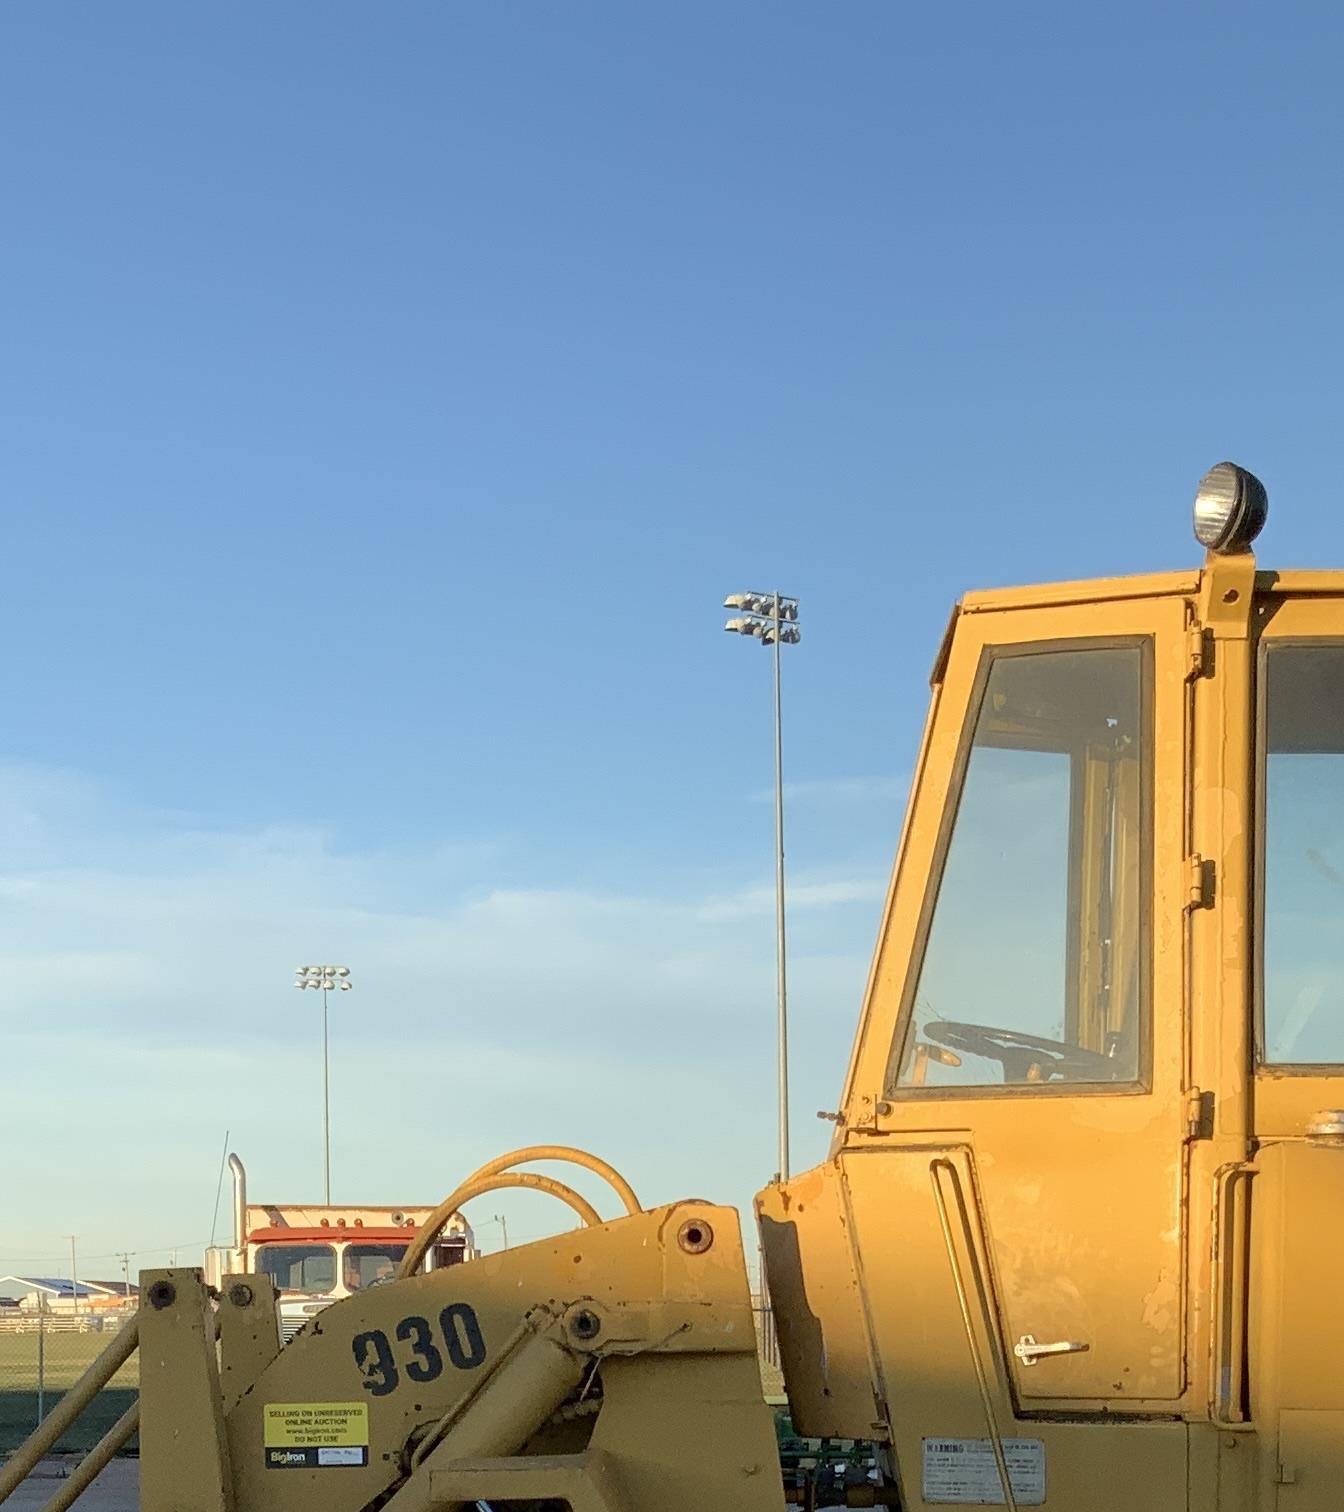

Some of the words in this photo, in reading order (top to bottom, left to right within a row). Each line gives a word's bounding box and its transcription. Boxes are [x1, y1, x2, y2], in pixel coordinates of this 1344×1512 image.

[352, 1303, 487, 1397] 930
[269, 1410, 300, 1418] SELLING
[314, 1409, 363, 1417] UNRESERVED
[314, 1418, 348, 1426] AUCTION
[323, 1435, 339, 1443] USE
[926, 1444, 964, 1453] WARNING
[270, 1451, 306, 1464] BigIron
